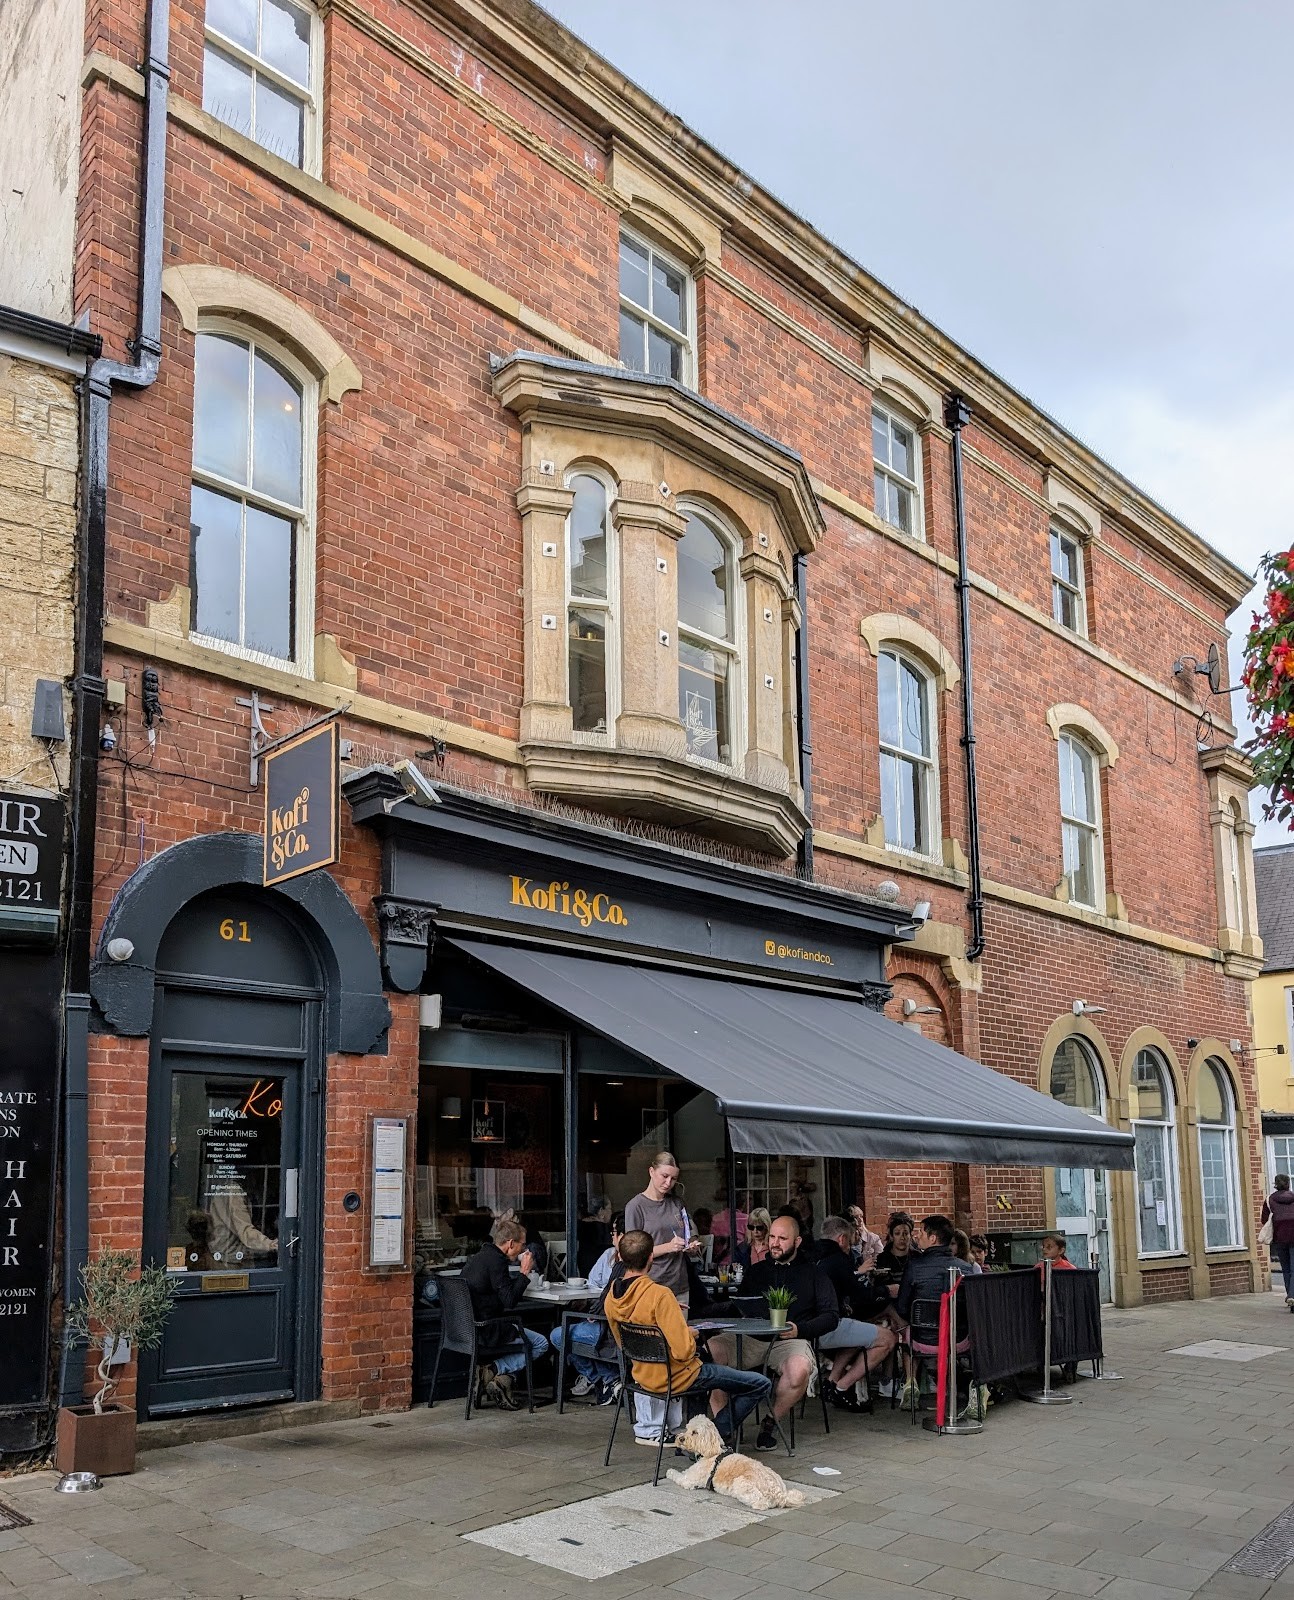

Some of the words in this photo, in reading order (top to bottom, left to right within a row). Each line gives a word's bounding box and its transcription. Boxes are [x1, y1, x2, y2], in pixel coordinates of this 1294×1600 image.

[270, 786, 310, 837] Kofi
[271, 829, 310, 871] &Co.
[0, 878, 43, 901] 121
[508, 874, 628, 928] Kofi&Co.
[219, 918, 252, 943] 61
[196, 1128, 234, 1138] OPENING
[234, 1129, 258, 1138] TIMES
[0, 1303, 27, 1316] 2121
